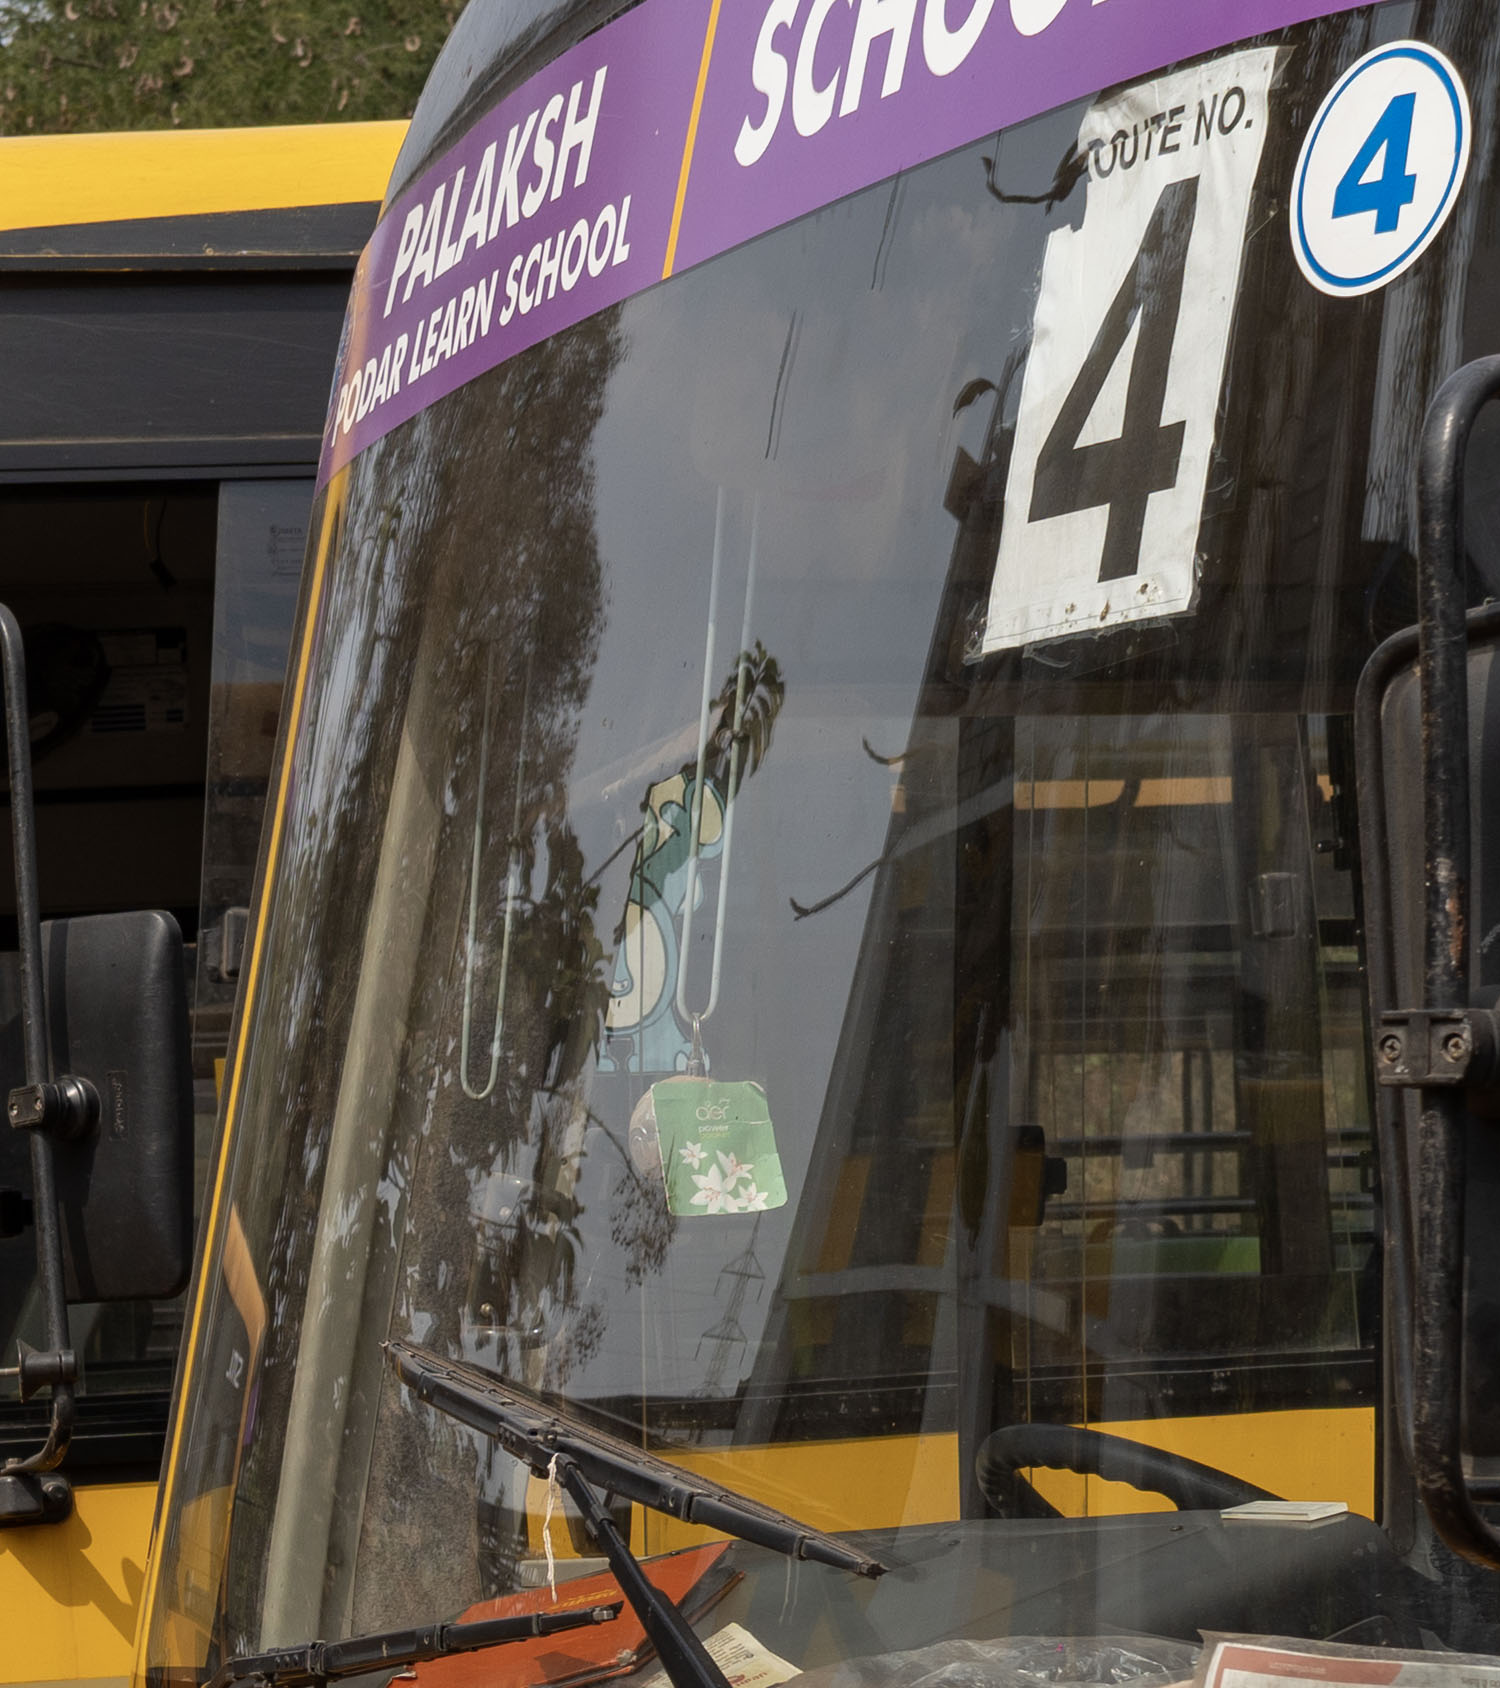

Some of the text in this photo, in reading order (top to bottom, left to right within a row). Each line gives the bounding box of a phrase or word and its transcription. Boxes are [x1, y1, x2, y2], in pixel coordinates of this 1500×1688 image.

[384, 65, 608, 319] PALAKSH
[1193, 87, 1252, 147] NO.
[1332, 92, 1417, 234] 4
[331, 195, 631, 448] PODAR LEARN SCHOOL
[1027, 174, 1200, 583] 4
